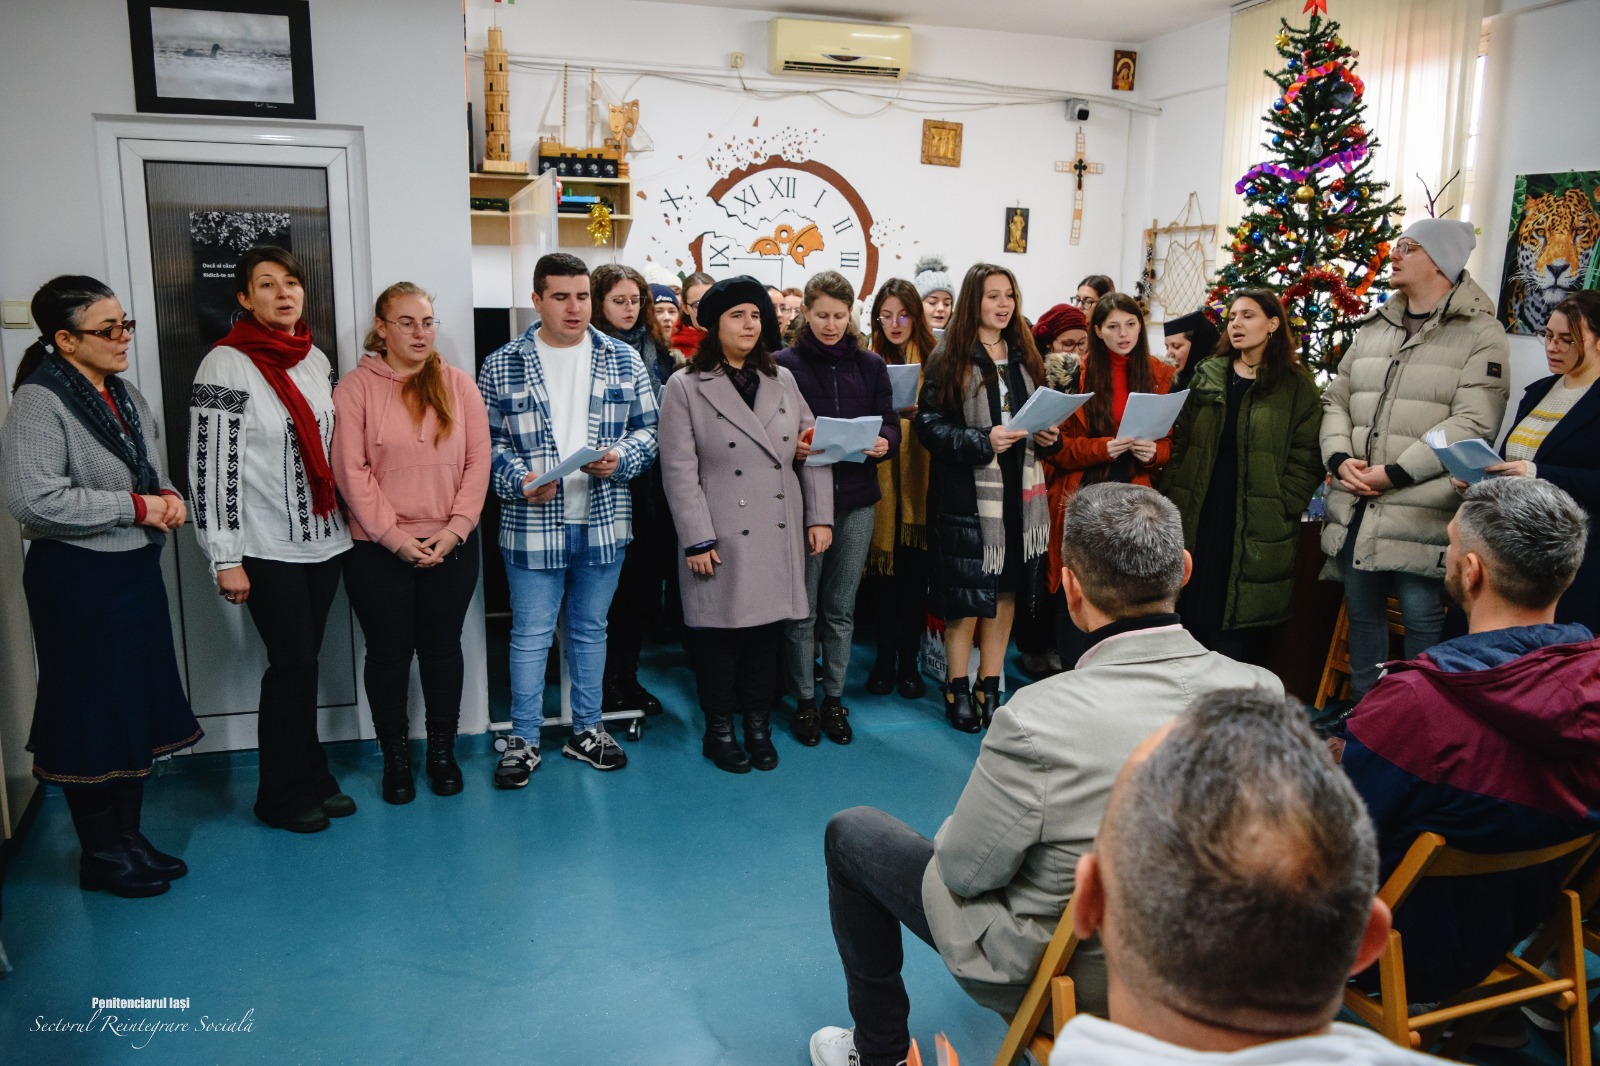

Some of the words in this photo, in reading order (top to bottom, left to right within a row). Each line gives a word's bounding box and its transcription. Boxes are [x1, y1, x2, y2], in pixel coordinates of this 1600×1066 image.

[733, 184, 761, 214] XI
[767, 177, 797, 199] XII
[813, 189, 827, 208] I
[660, 188, 683, 211] X
[832, 217, 853, 235] II
[710, 245, 729, 268] IX
[840, 251, 859, 268] III
